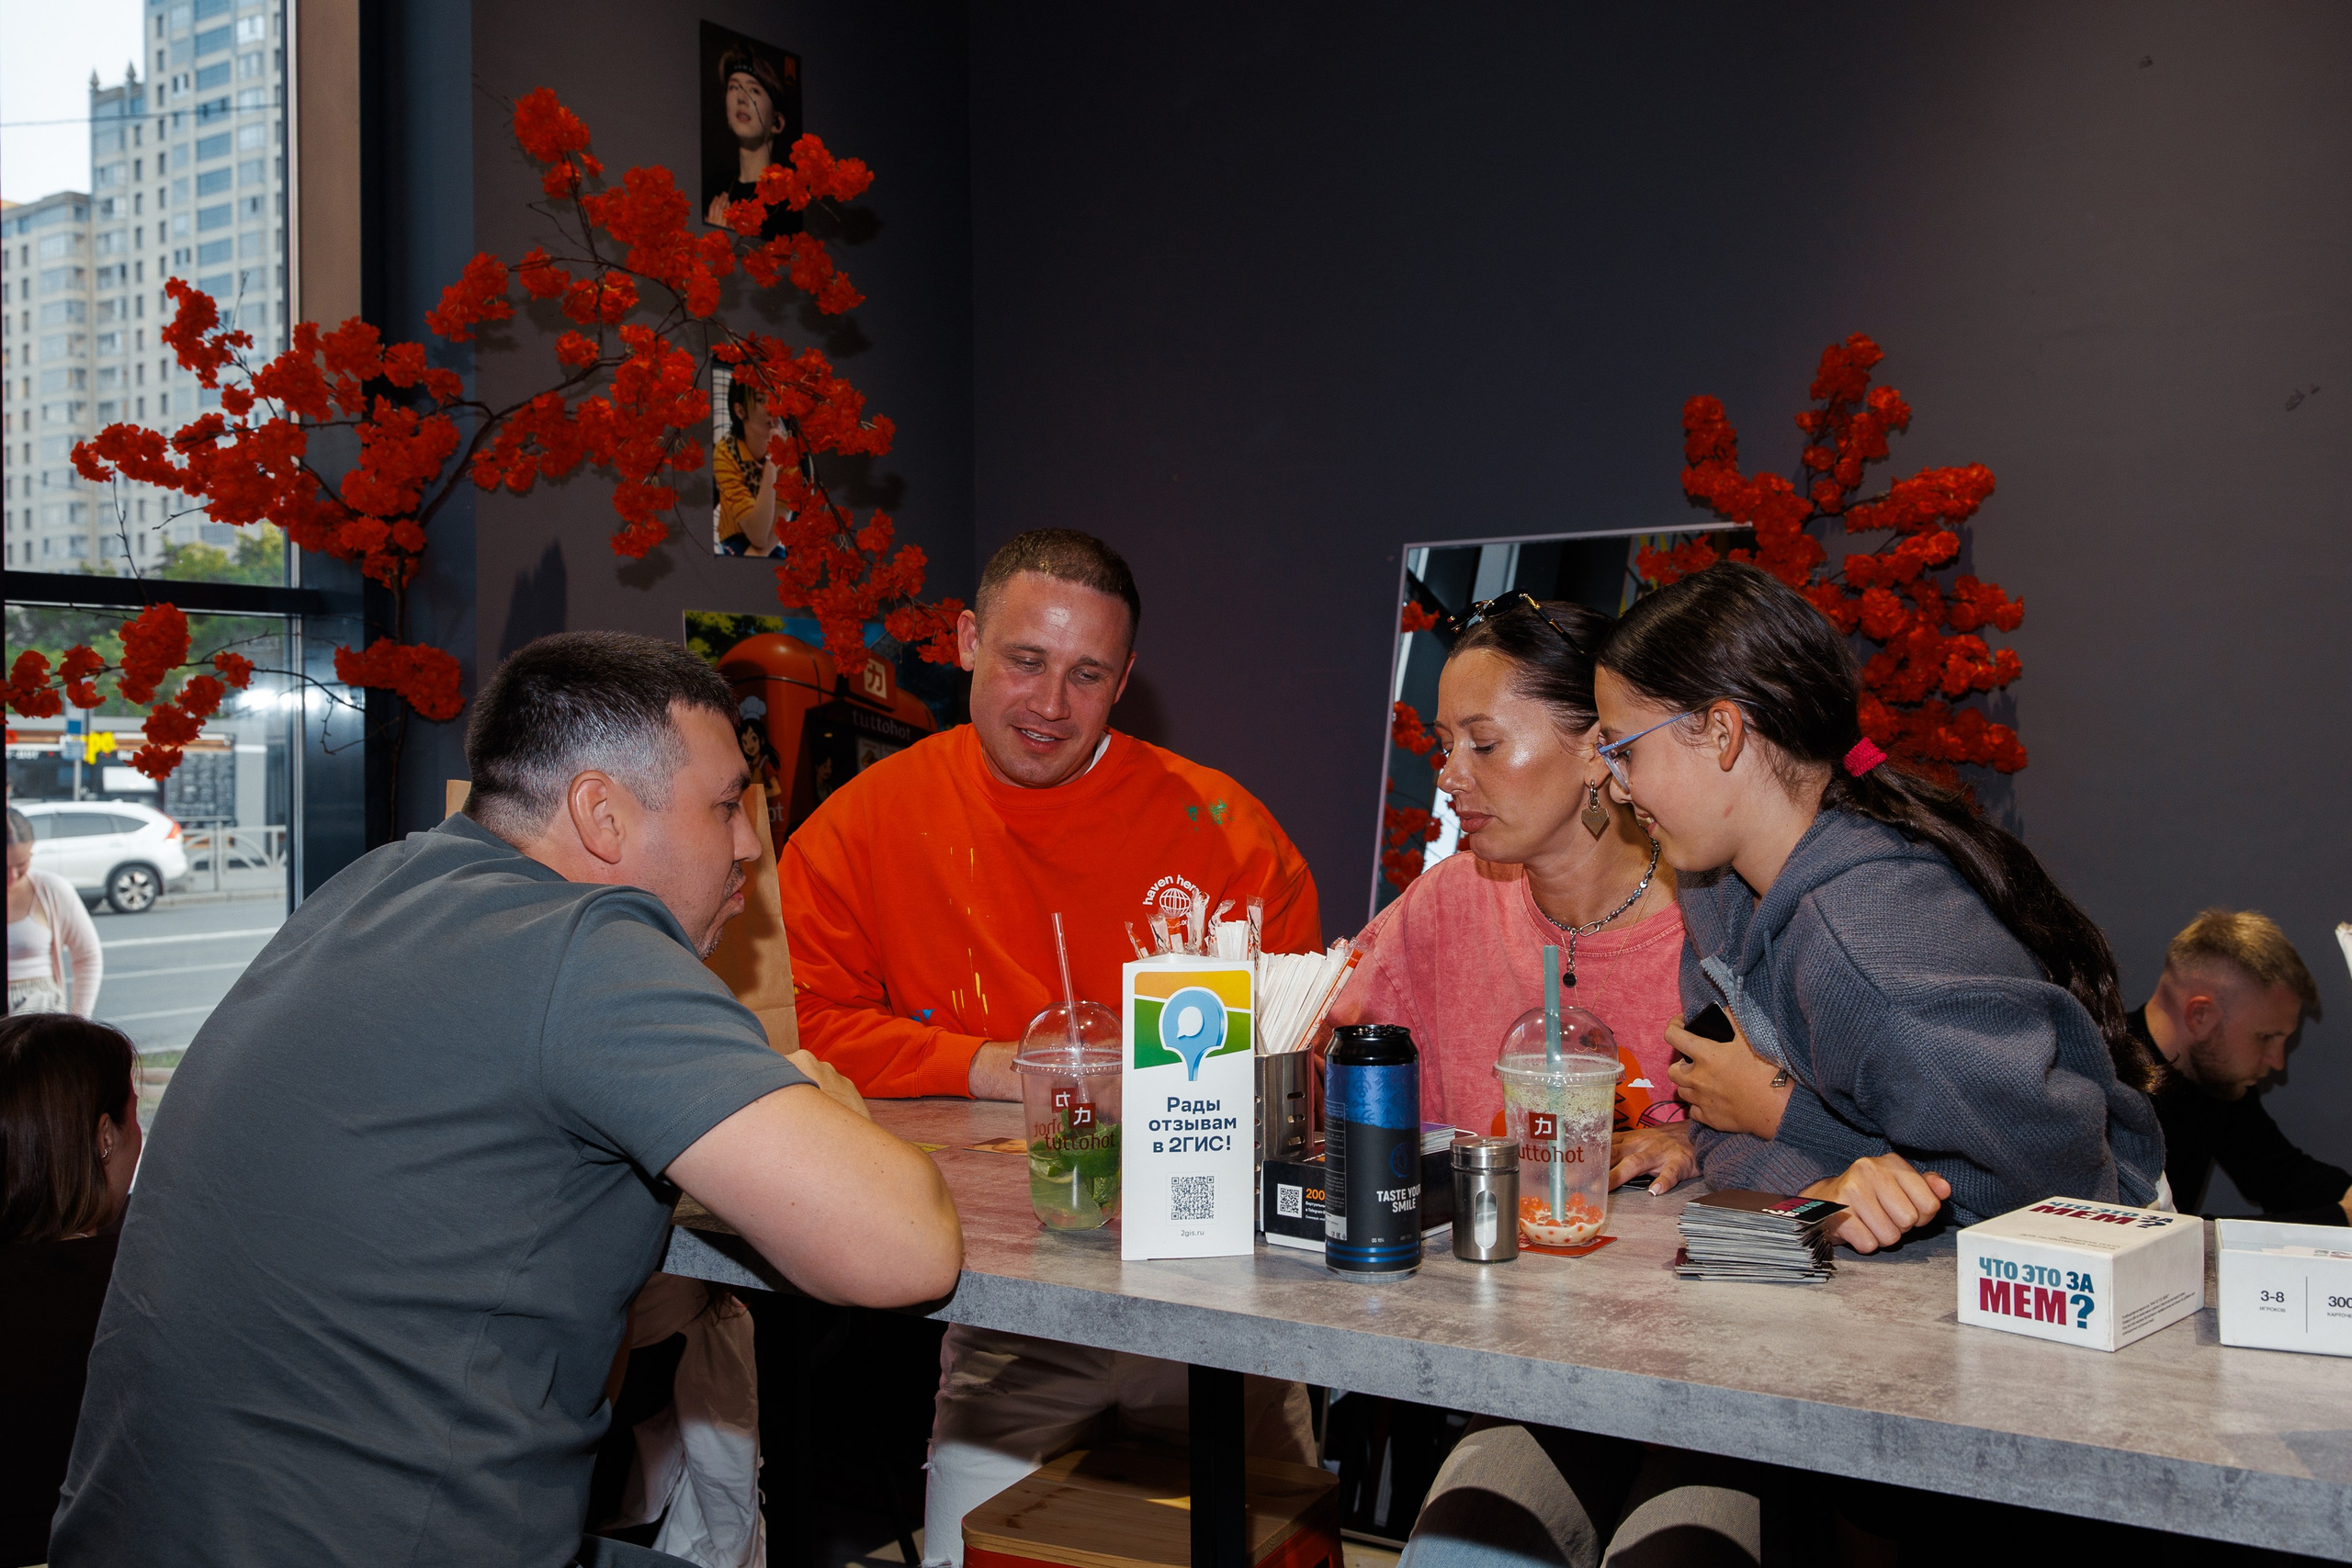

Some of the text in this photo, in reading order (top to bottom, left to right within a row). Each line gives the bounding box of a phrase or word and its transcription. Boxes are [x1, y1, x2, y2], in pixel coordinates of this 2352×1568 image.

[852, 709, 910, 739] tuttohot
[1142, 874, 1200, 906] haven her
[1167, 1096, 1221, 1114] Рады
[1148, 1117, 1237, 1132] отзывам
[1045, 1132, 1115, 1151] tuttohot
[1152, 1134, 1231, 1153] в 2ГИС!
[1518, 1144, 1585, 1164] uttohot
[1306, 1188, 1326, 1201] 200
[1376, 1189, 1406, 1201] TASTE
[1392, 1198, 1417, 1213] SMILE
[2049, 1201, 2175, 1224] ЧТО ЭТО ЗА
[1181, 1229, 1204, 1237] 2gis.ru
[1979, 1256, 2095, 1294] ЧТО ЭТО ЗА
[2260, 1290, 2285, 1303] 3-8
